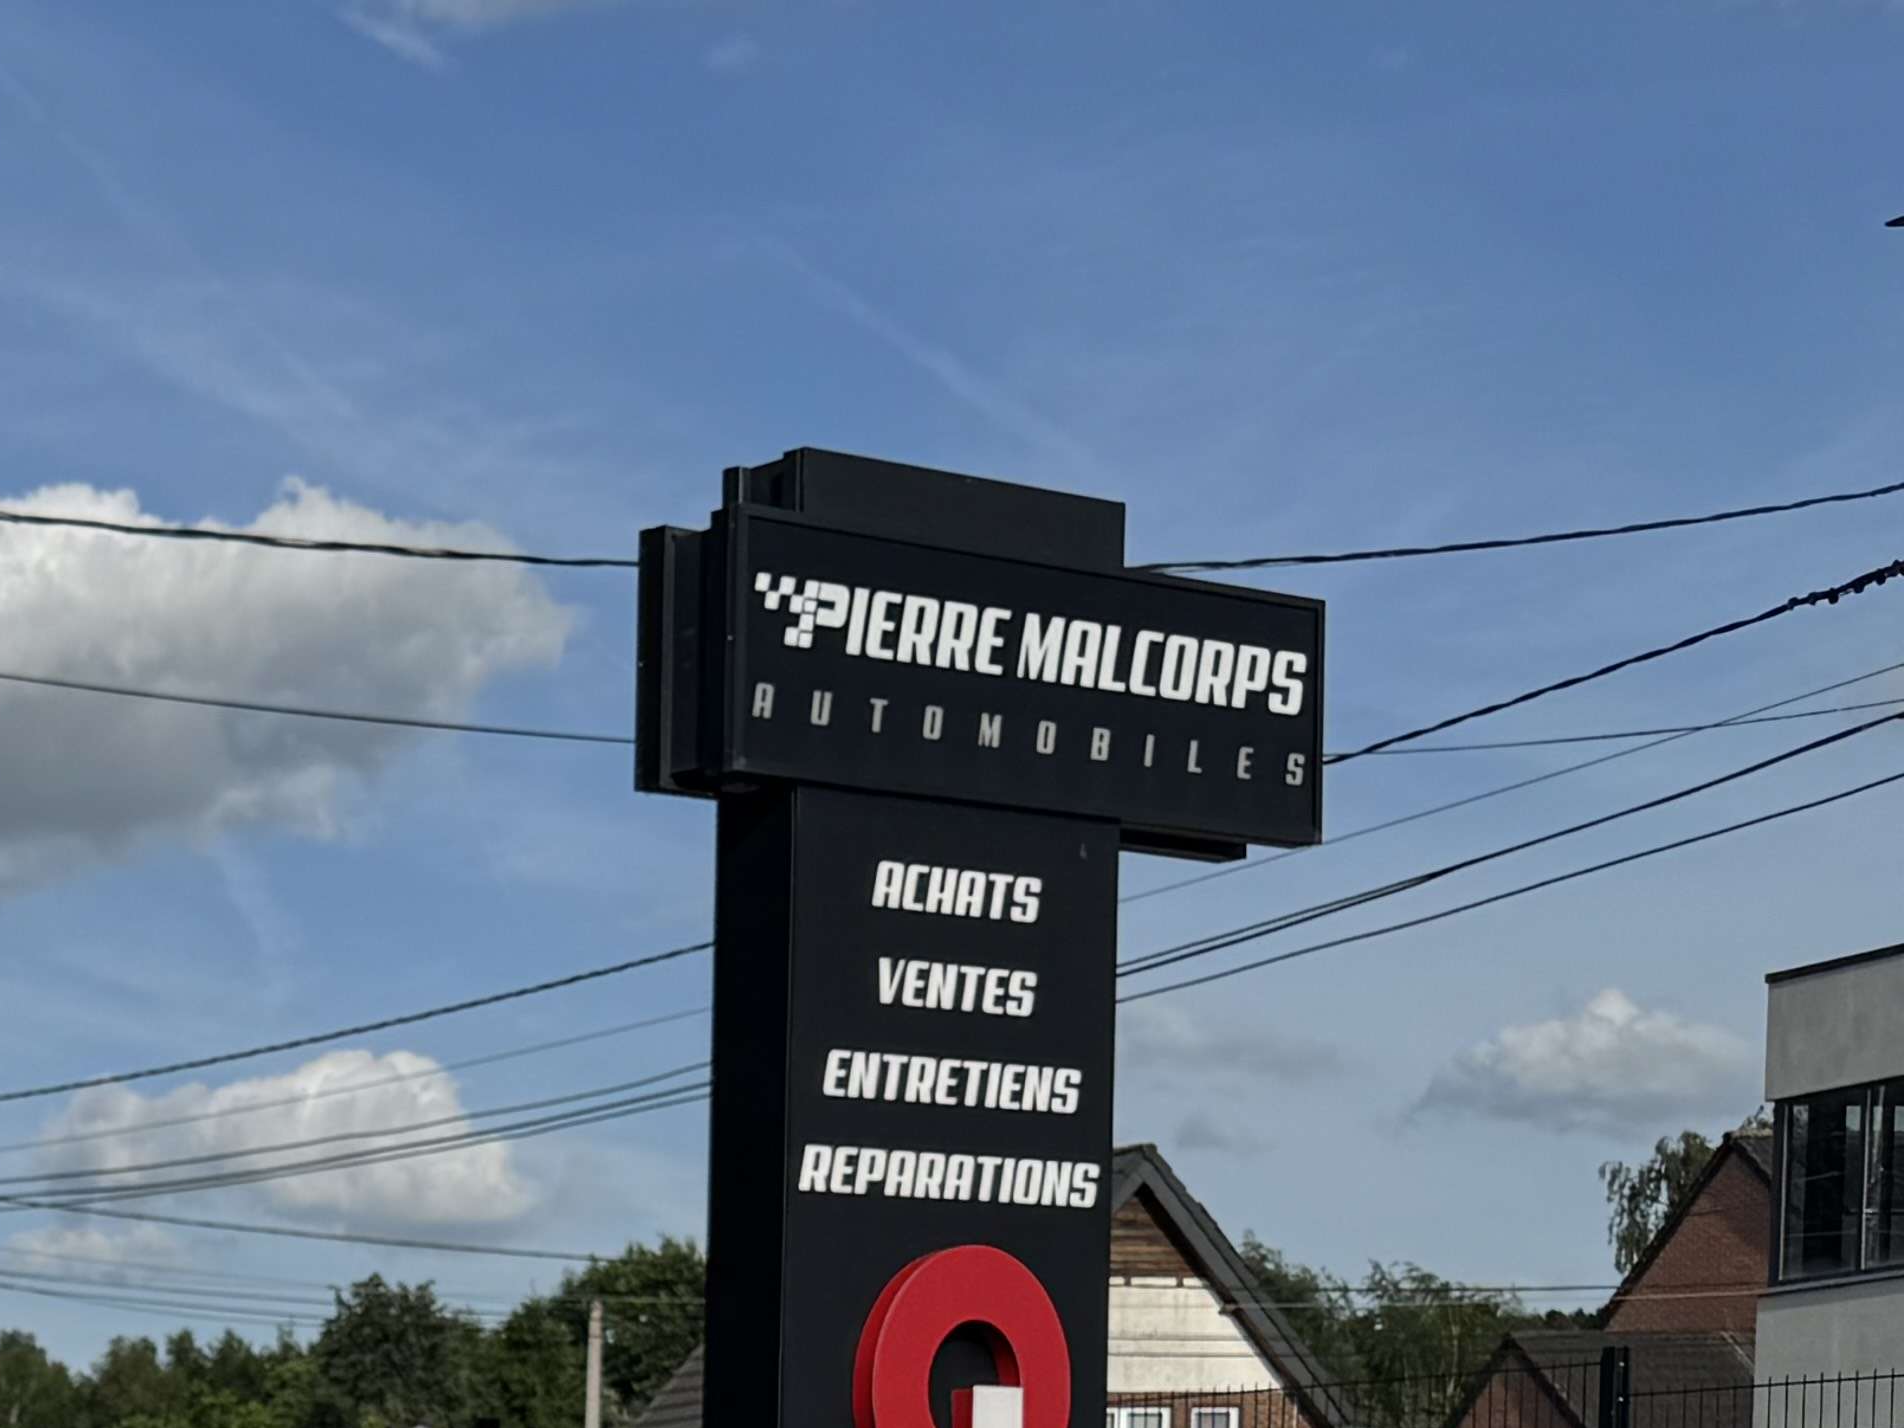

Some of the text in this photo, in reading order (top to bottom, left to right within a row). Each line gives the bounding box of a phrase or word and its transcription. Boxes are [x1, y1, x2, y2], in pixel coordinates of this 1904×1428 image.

[784, 580, 1308, 717] PIERRE MALCORPS
[751, 682, 1306, 787] AUTOMOBILES
[872, 860, 1042, 923] ACHATS
[878, 957, 1038, 1018] VENTES
[822, 1049, 1083, 1114] ENTRETIENS
[798, 1143, 1101, 1208] REPARATIONS
